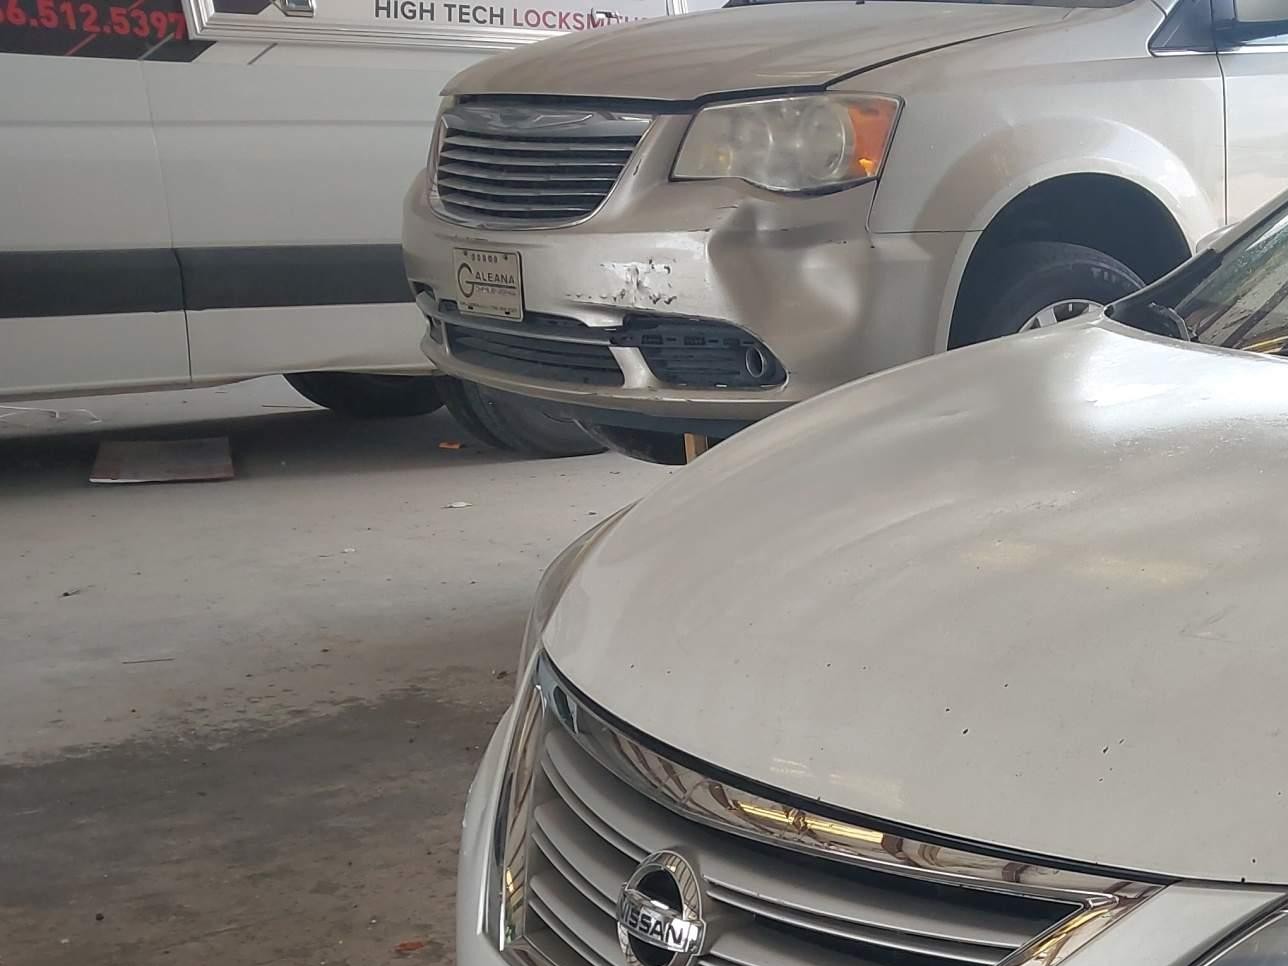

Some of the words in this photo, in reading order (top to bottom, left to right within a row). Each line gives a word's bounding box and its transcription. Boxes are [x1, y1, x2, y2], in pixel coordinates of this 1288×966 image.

[0, 0, 186, 39] 6.512.5397
[374, 0, 435, 21] HIGH
[443, 3, 505, 26] TECH
[458, 263, 516, 298] GALEANA
[620, 901, 684, 945] NISSAN
